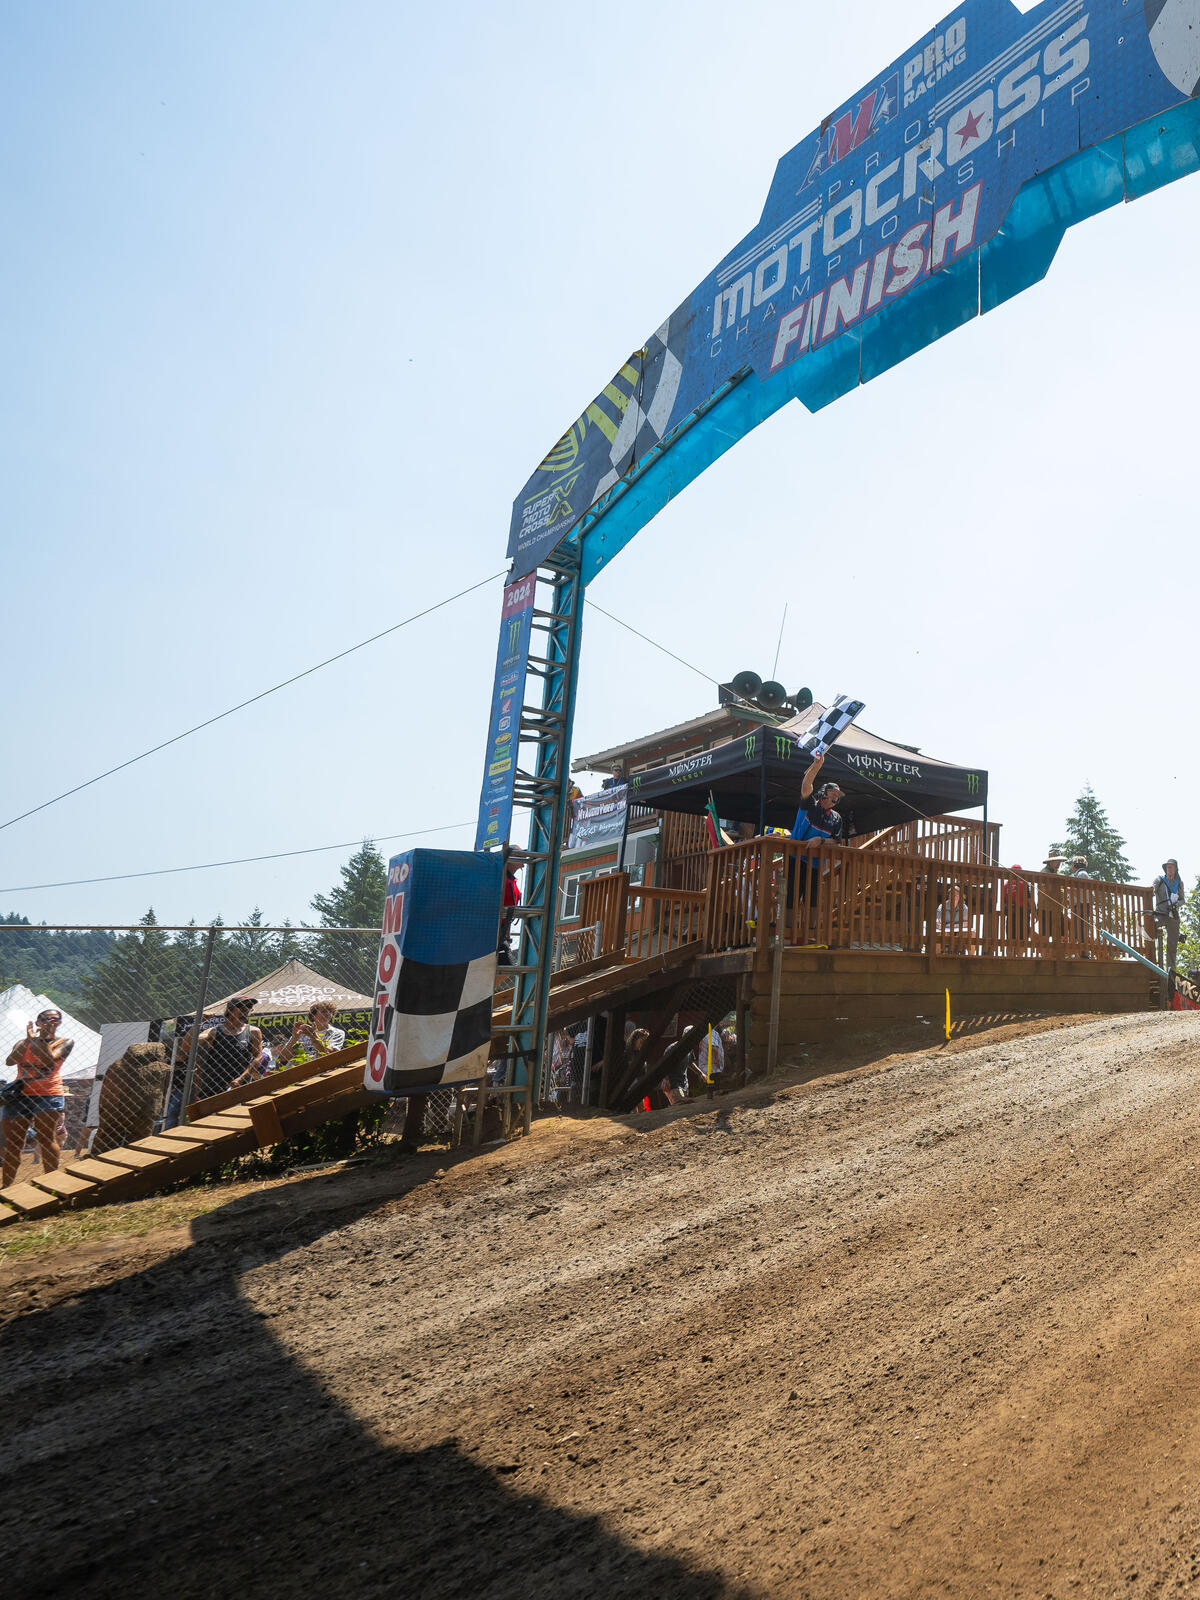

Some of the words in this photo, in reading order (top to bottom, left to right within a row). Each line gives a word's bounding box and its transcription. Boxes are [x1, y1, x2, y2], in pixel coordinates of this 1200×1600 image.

[903, 16, 967, 94] PRO
[903, 46, 967, 109] RACING
[796, 71, 900, 196] AMA
[827, 119, 921, 203] PRO
[711, 13, 1091, 340] MOTOCROSS
[710, 77, 1091, 359] CHAMPIONSHIP
[769, 179, 984, 372] FINISH
[521, 491, 559, 519] SUPER
[522, 504, 551, 528] MOTO
[519, 514, 550, 539] CROSS
[507, 582, 531, 608] 2024
[668, 753, 713, 778] MONSTER
[671, 770, 704, 785] ENERGY
[847, 752, 922, 779] MONSTER
[858, 769, 911, 785] ENERGY
[388, 861, 411, 887] PRO
